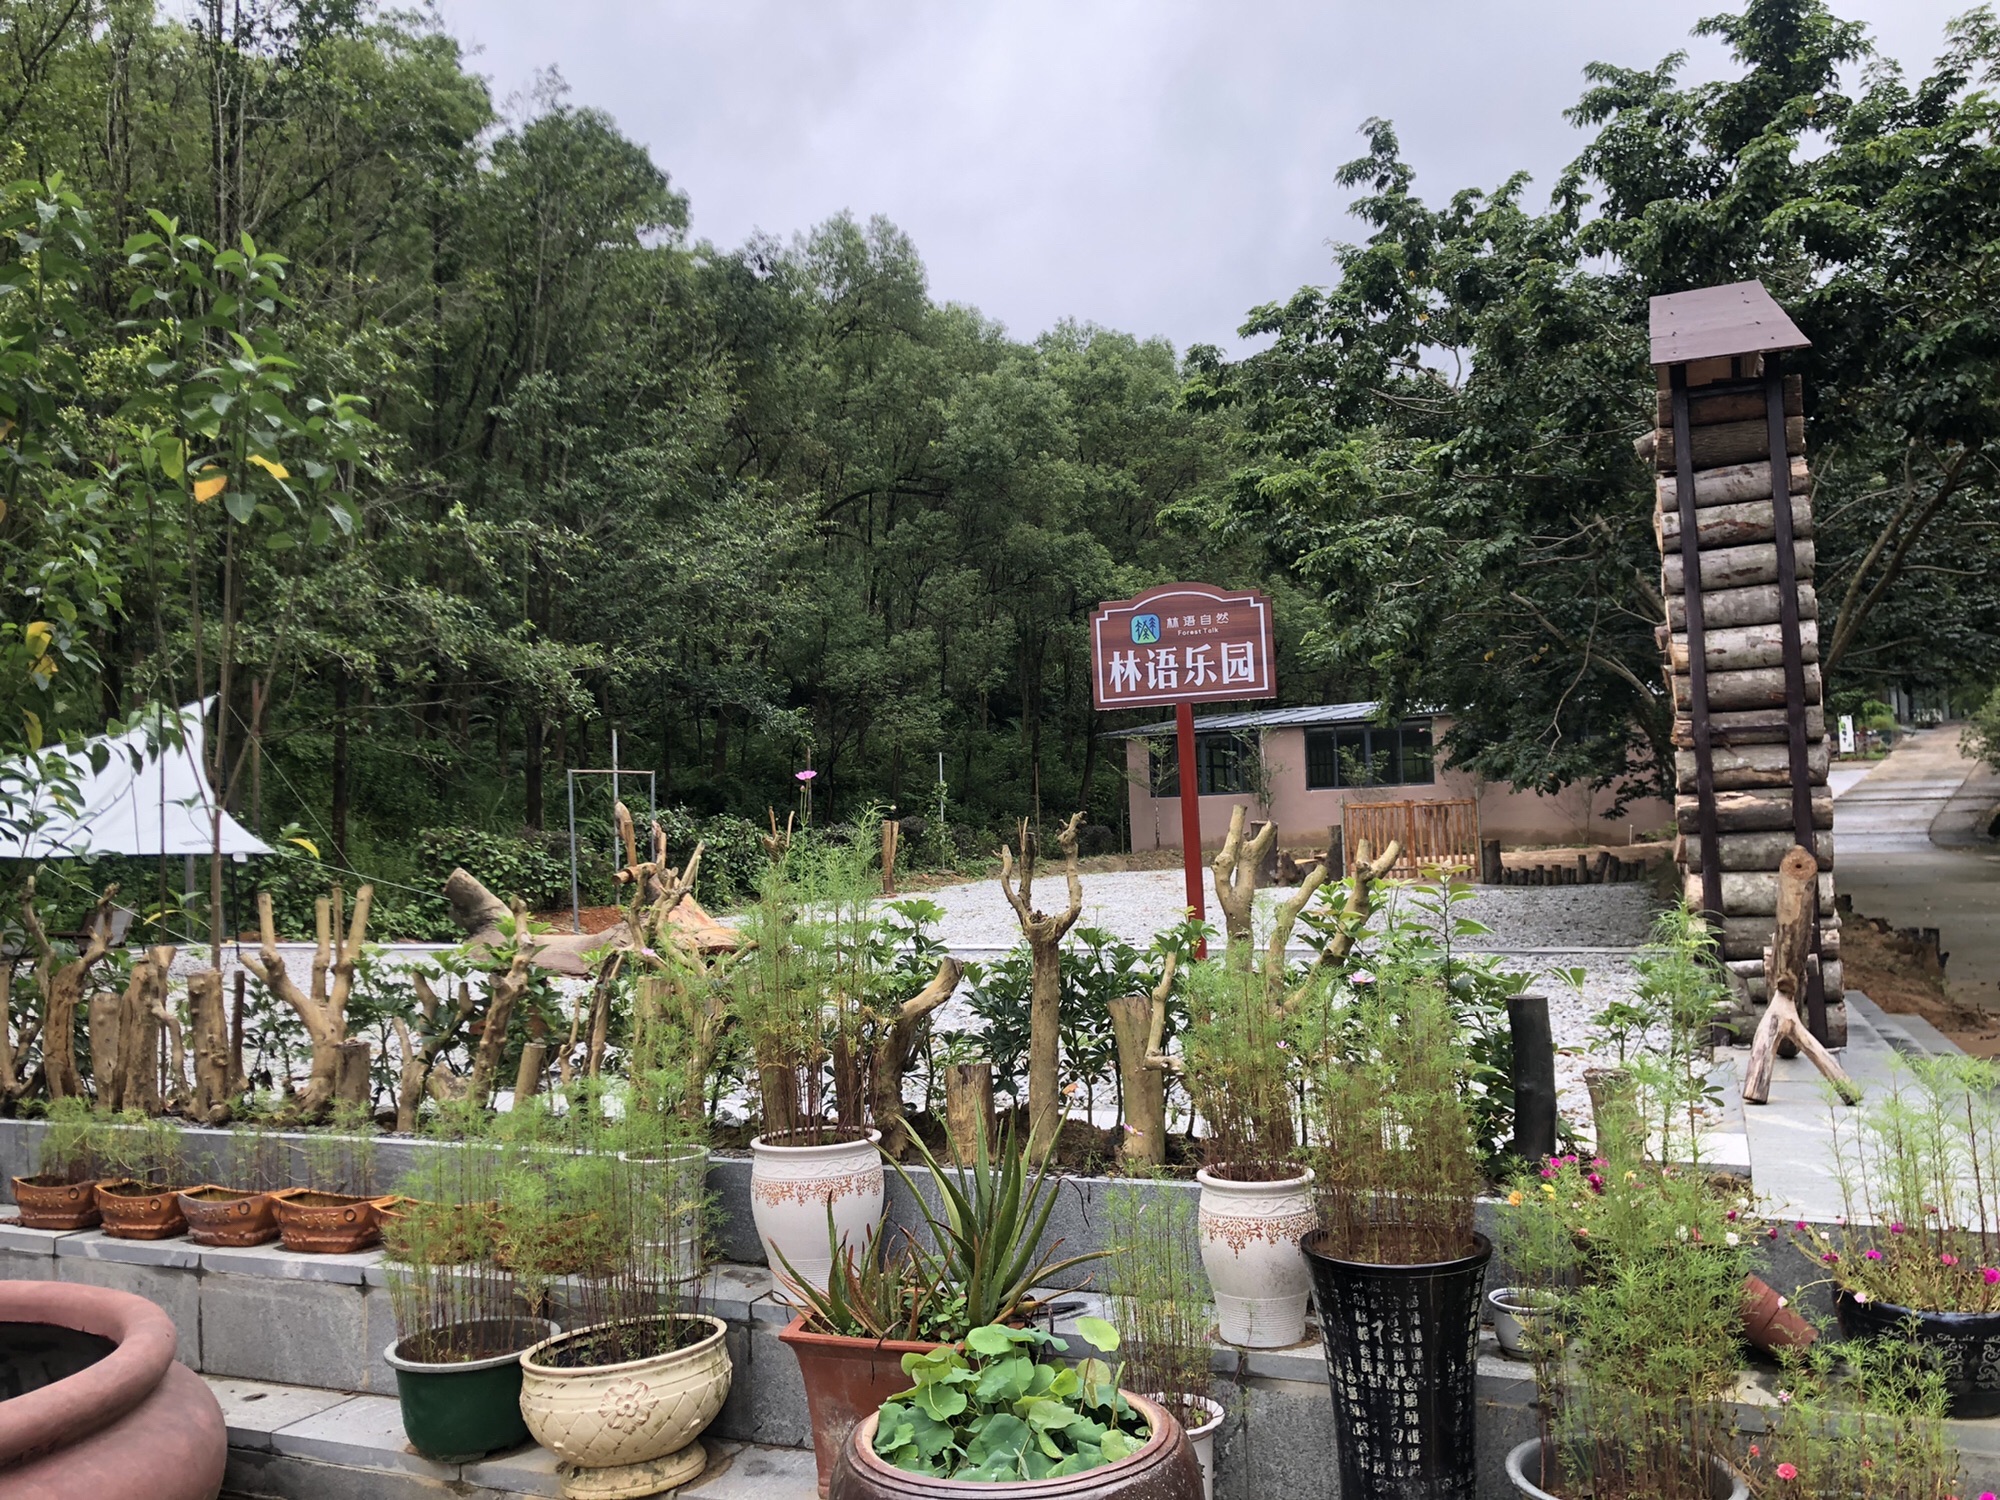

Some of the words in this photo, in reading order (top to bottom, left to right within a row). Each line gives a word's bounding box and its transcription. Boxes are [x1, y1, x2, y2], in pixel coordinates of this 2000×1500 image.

[1166, 612, 1229, 629] 林语自然
[1108, 641, 1255, 693] 林语乐园
